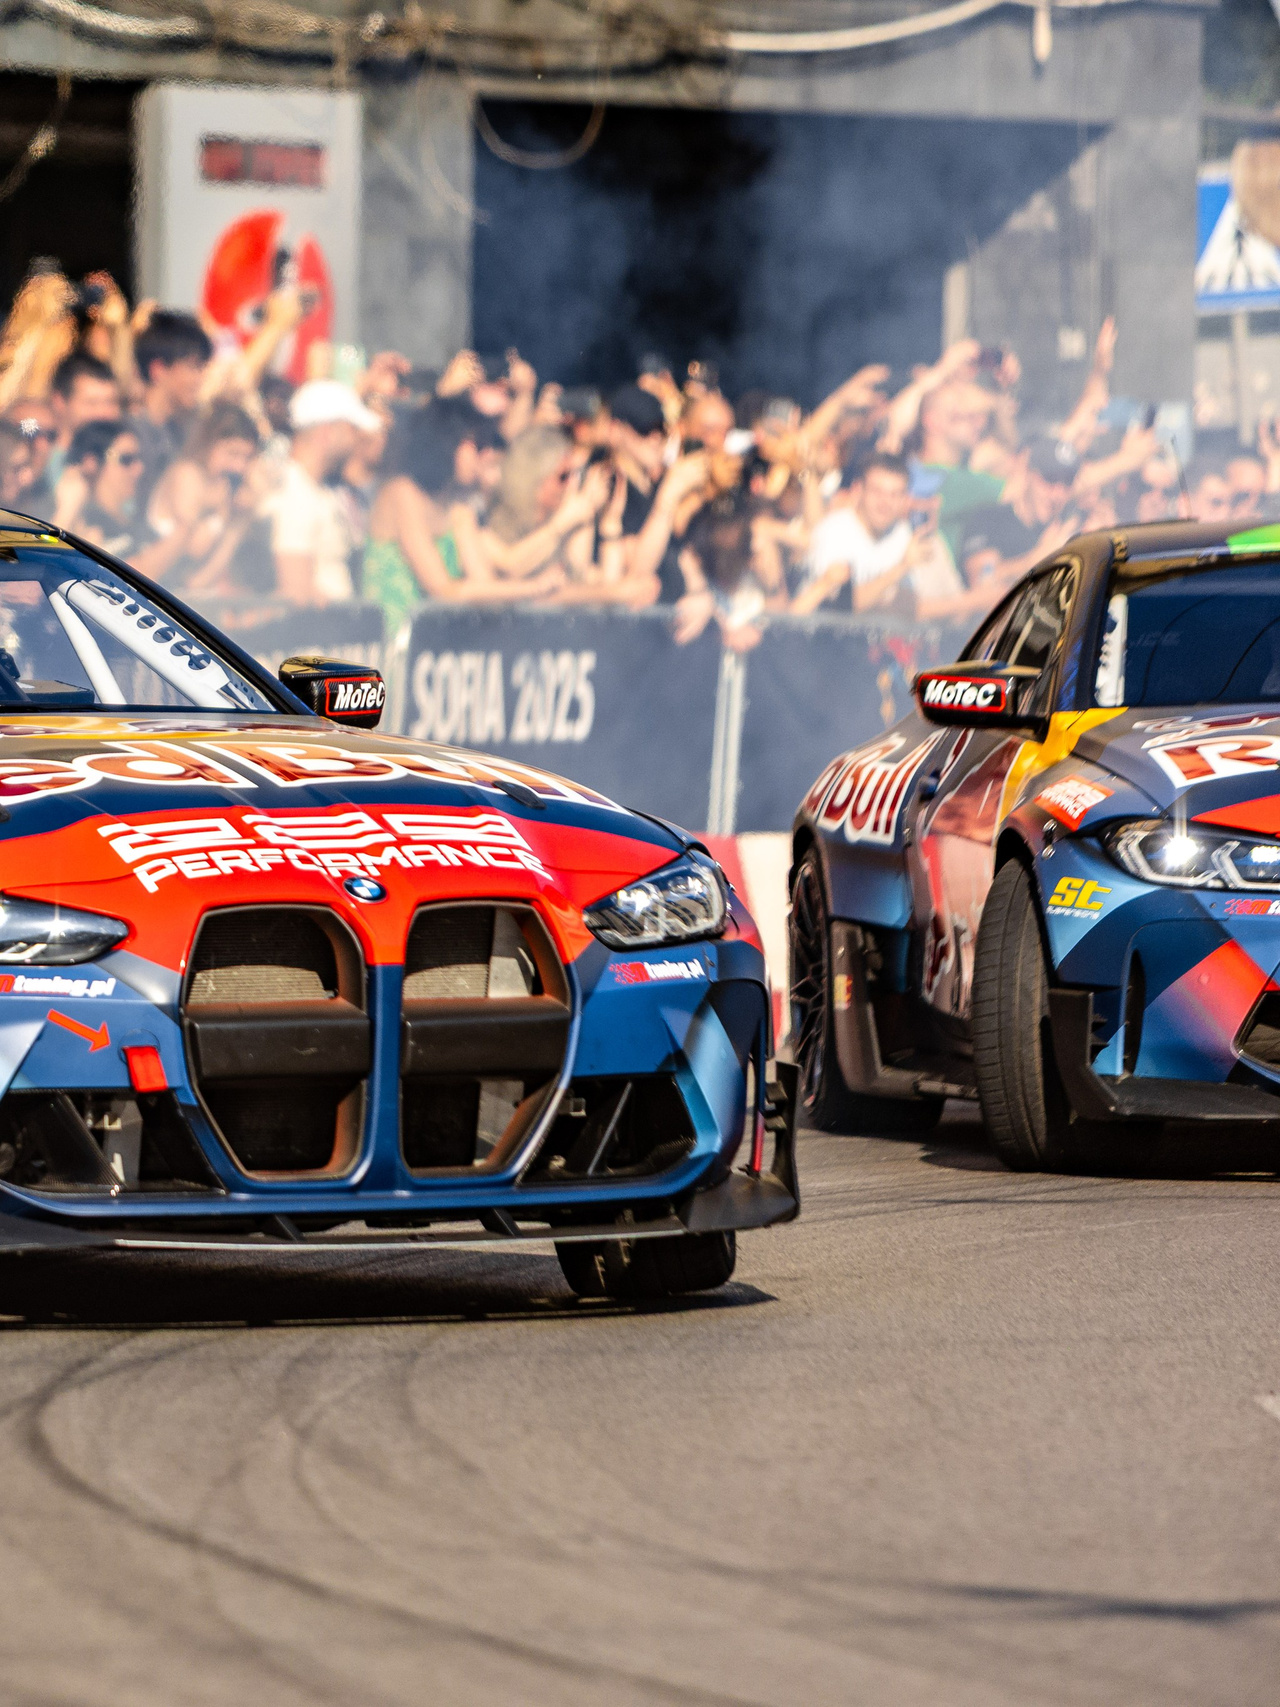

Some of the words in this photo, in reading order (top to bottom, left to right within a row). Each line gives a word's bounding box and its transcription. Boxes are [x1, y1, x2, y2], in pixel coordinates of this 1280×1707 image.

[334, 683, 385, 711] MoTeC
[410, 650, 505, 743] SOFIA
[510, 650, 597, 742] 2025
[924, 679, 997, 708] MoTeC
[189, 741, 632, 816] Bull
[134, 843, 554, 893] PERFORMANCE
